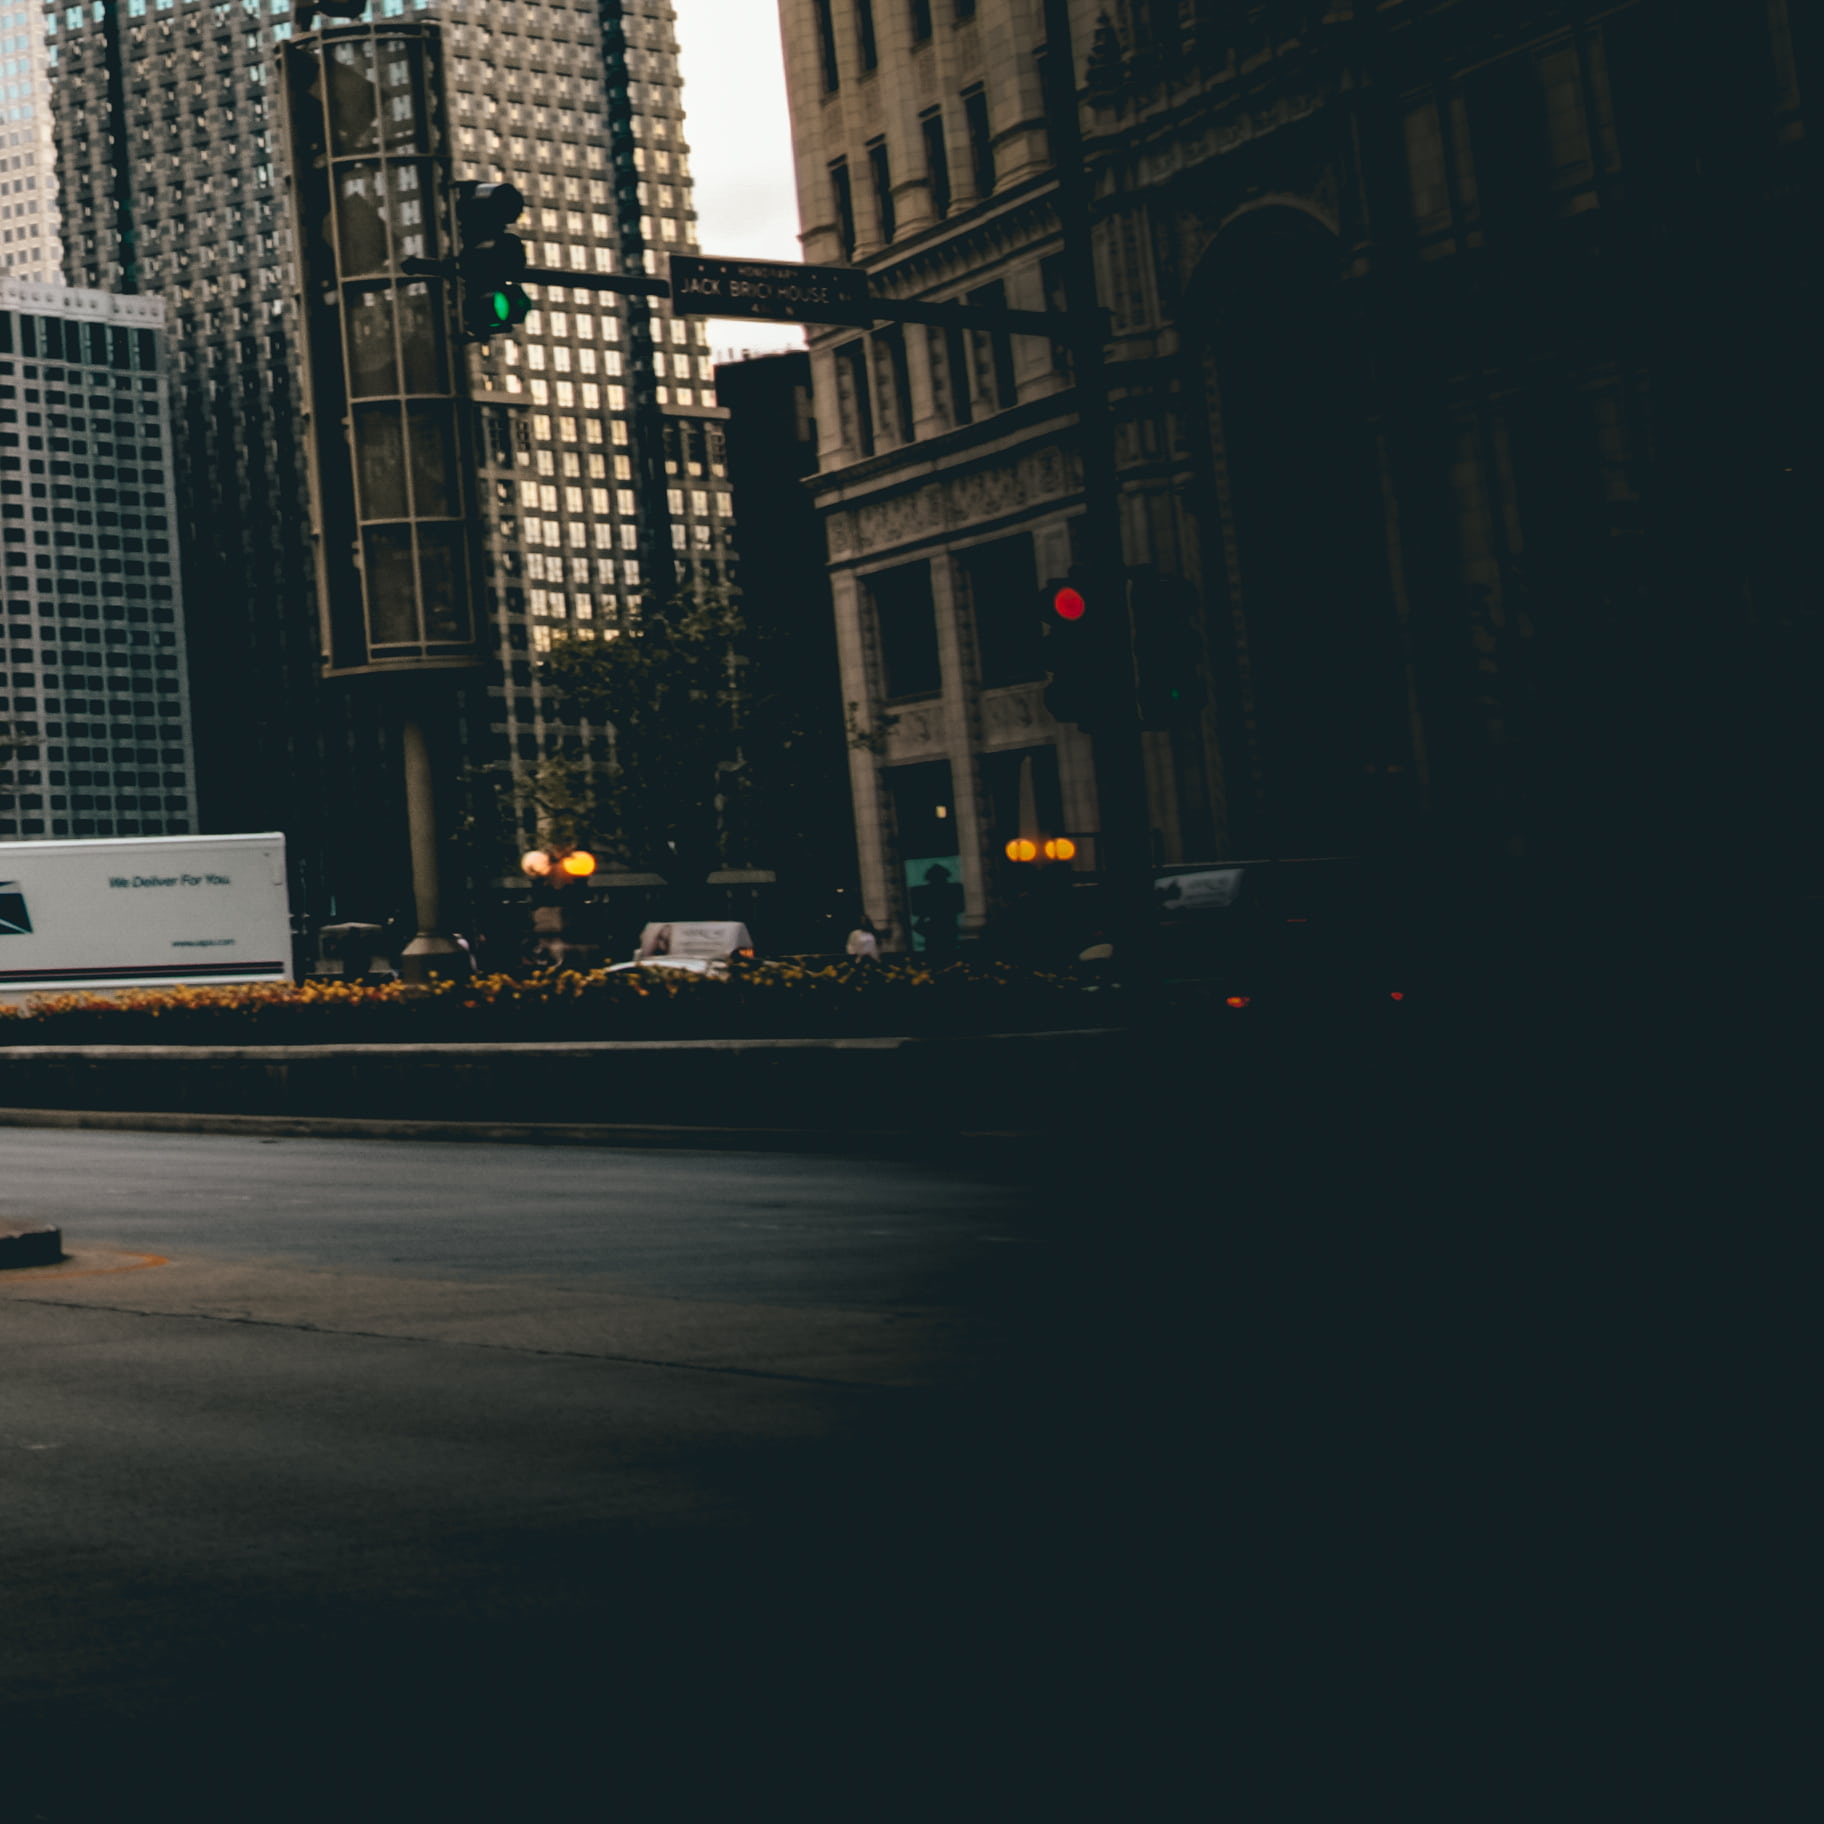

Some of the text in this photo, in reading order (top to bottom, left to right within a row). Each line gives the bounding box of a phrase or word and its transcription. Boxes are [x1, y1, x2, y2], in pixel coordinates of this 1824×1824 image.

[679, 276, 722, 296] JACK
[728, 279, 831, 304] BRICHOUSE
[108, 876, 130, 888] We
[132, 875, 178, 888] Deliver
[180, 873, 202, 885] For
